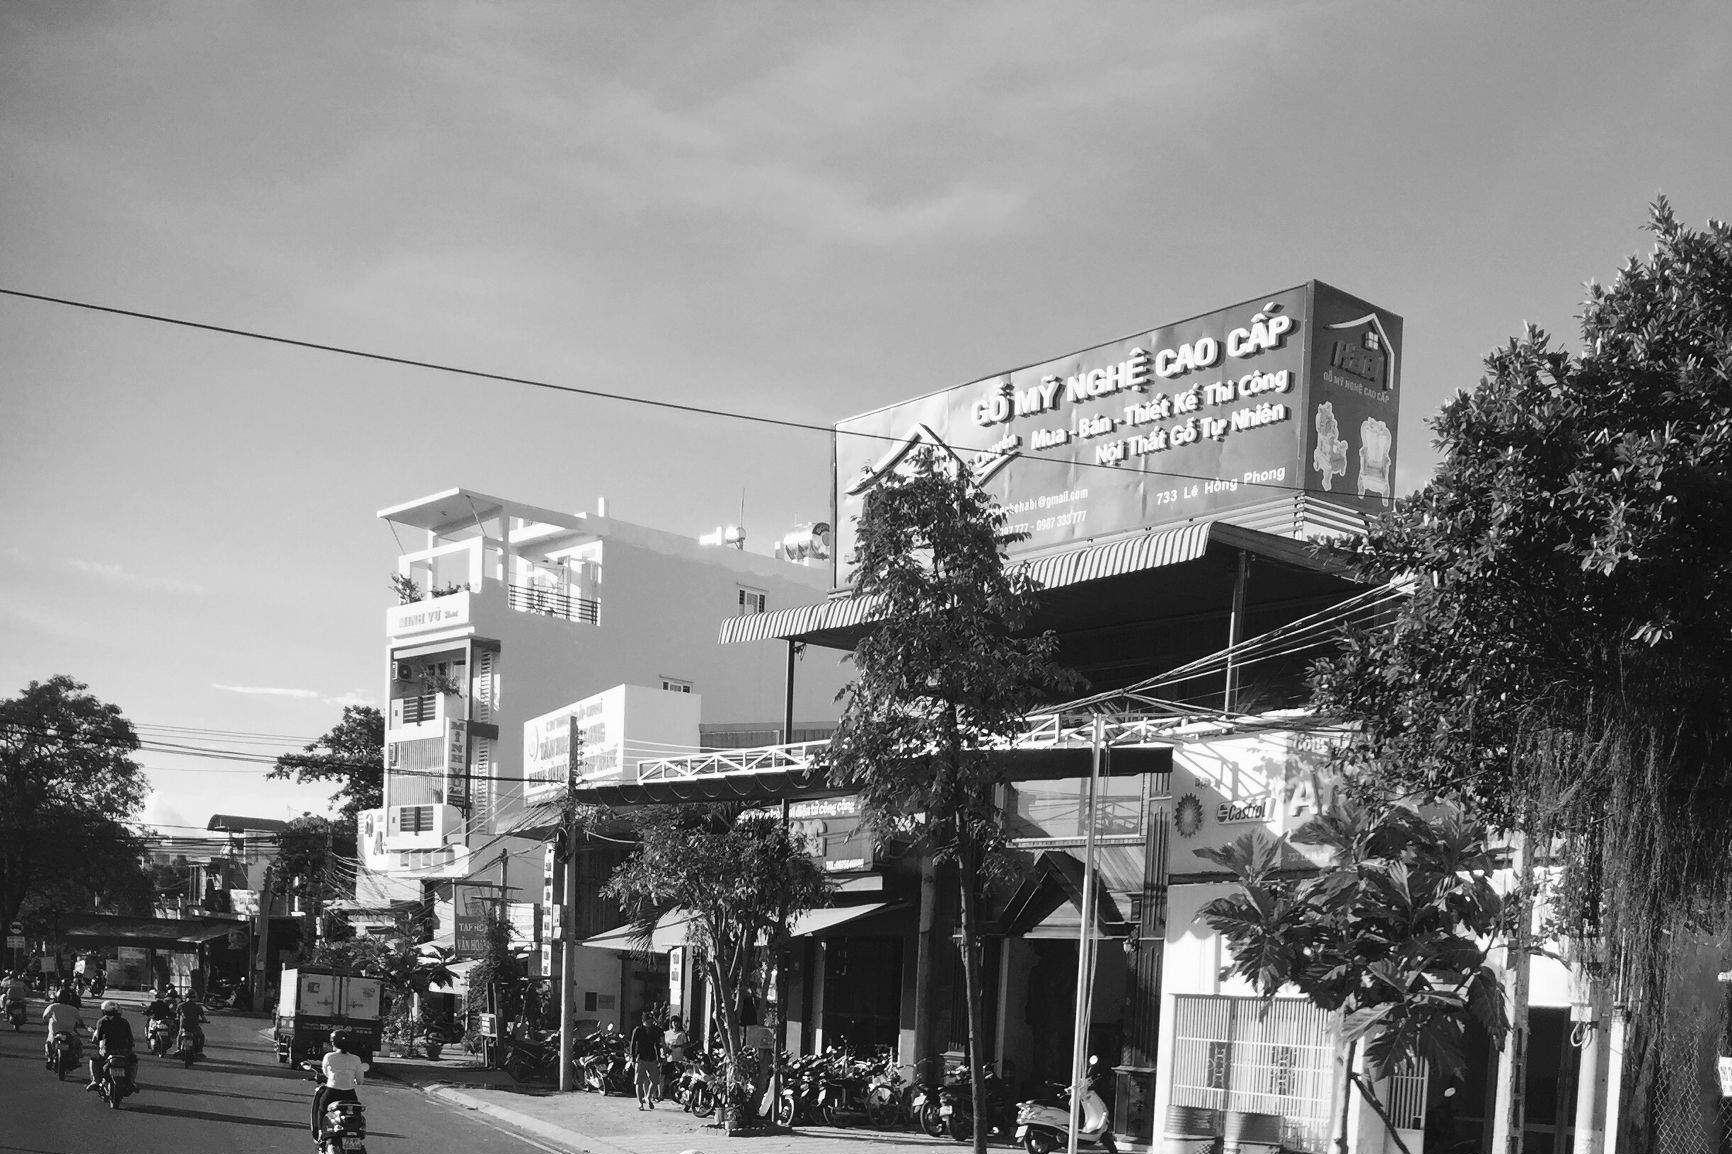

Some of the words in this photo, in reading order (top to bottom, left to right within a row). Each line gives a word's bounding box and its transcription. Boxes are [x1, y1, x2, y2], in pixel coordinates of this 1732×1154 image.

[975, 382, 1010, 424] GỖ
[1014, 375, 1060, 416] MỸ
[1066, 348, 1147, 402] NGHỆ
[1155, 337, 1217, 378] CAO
[1227, 302, 1291, 358] CẤP
[1031, 428, 1067, 450] Mua
[1079, 413, 1113, 438] Bán
[1124, 393, 1171, 426] Thiết
[1174, 383, 1200, 414] Kế
[1204, 382, 1235, 405] Thi
[1238, 368, 1287, 396] Công
[1363, 387, 1376, 399] CAO
[1096, 441, 1124, 465] Nội
[1126, 426, 1168, 456] Thất
[1170, 417, 1197, 445] Gỗ
[1201, 417, 1227, 440] Tự
[1231, 402, 1285, 431] Nhiên
[1157, 489, 1178, 505] 733
[1184, 484, 1198, 499] Lê
[1205, 477, 1238, 495] Hồng
[1243, 467, 1286, 485] Phong
[1036, 515, 1055, 531] 0987
[1228, 801, 1266, 821] Castrol
